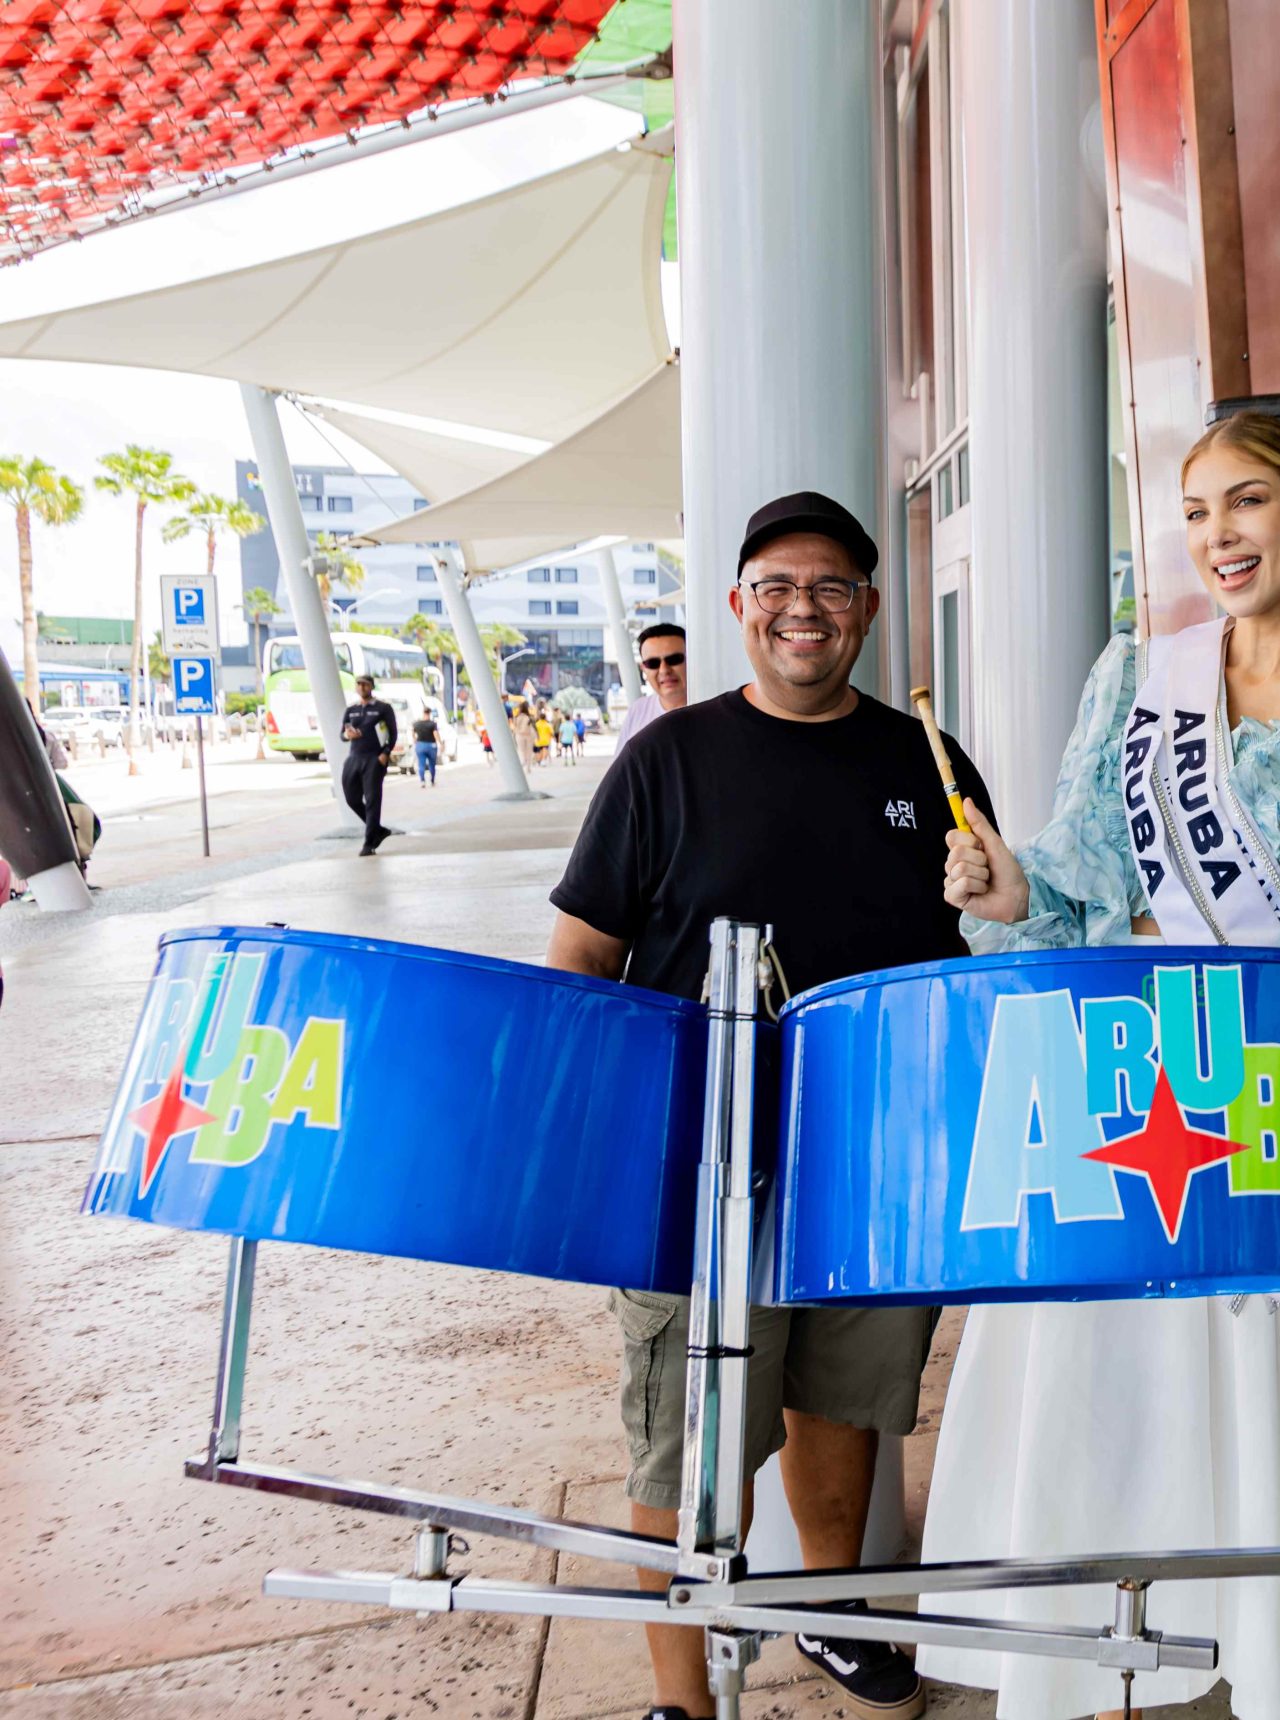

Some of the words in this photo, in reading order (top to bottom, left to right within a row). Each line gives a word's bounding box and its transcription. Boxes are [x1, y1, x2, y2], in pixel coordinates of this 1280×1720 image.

[179, 589, 199, 615] P
[180, 660, 205, 692] P
[1125, 706, 1166, 900] ARUBA
[1173, 709, 1242, 901] ARUBA
